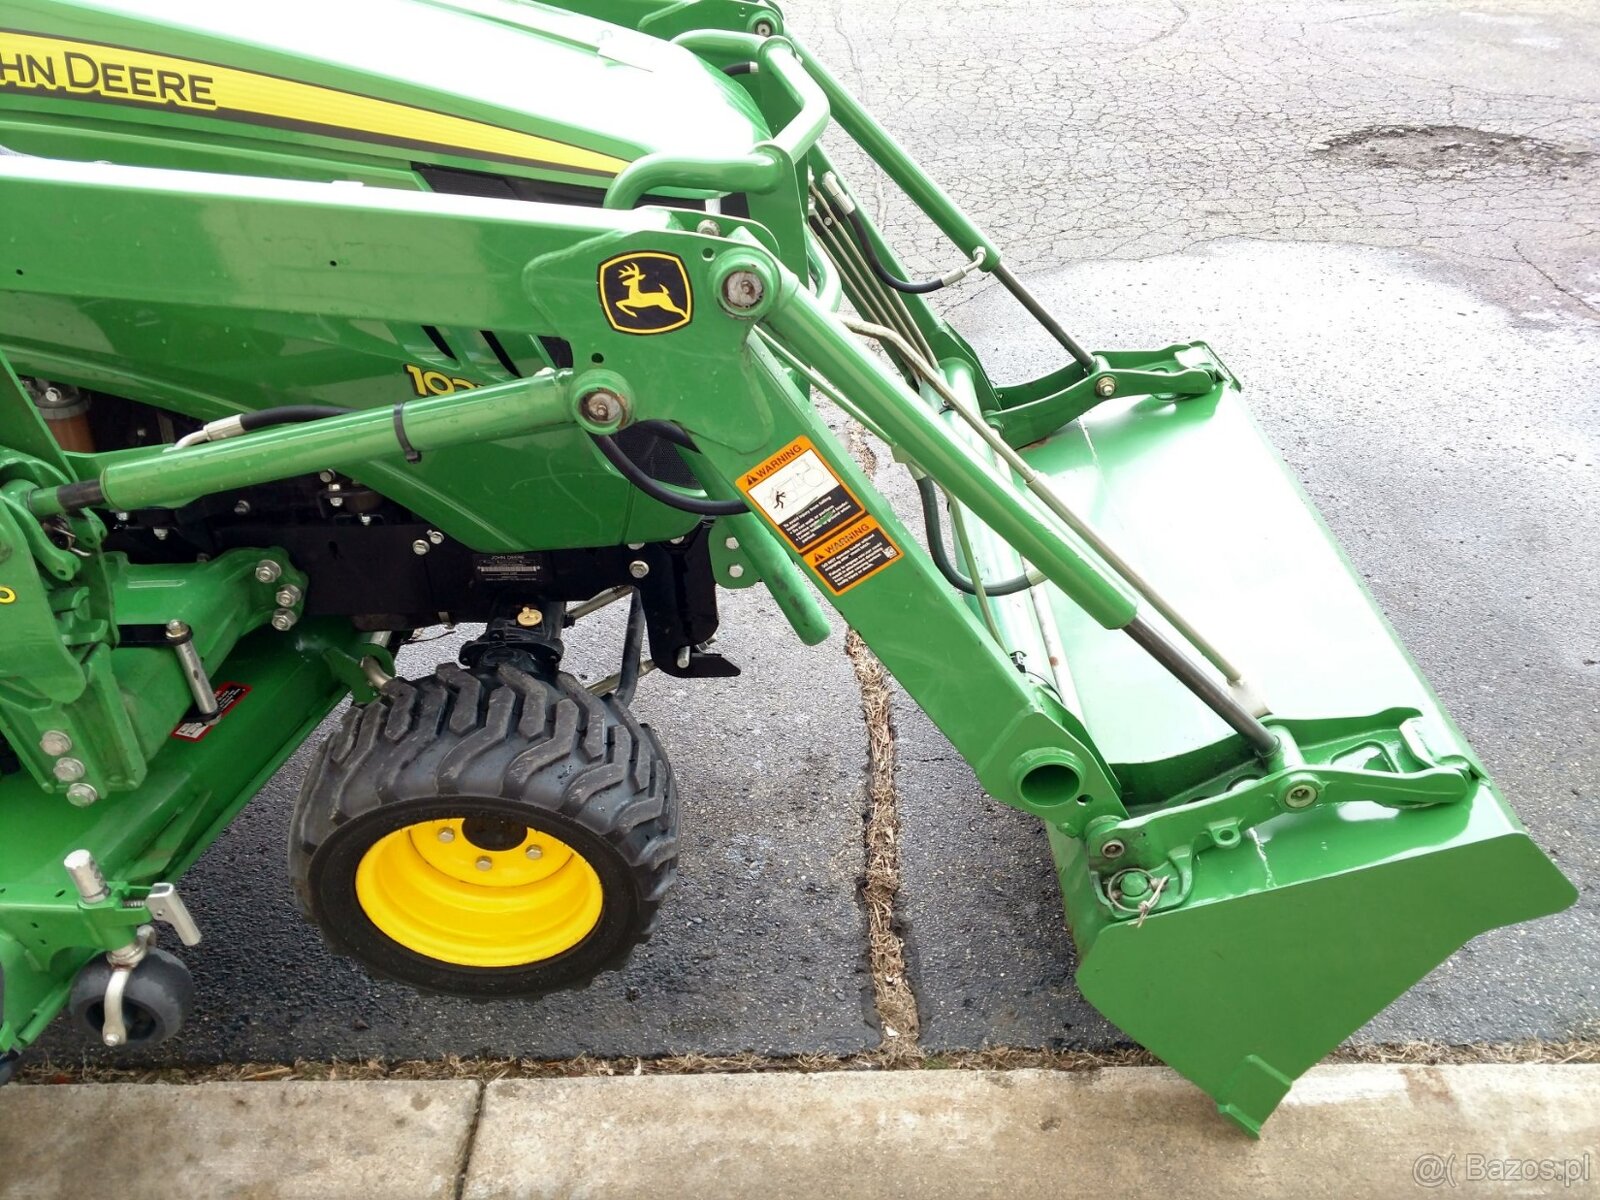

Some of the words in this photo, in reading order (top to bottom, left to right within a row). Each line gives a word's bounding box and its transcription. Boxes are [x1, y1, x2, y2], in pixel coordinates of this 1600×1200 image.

[64, 51, 216, 106] DEERE
[404, 364, 484, 397] 10
[757, 444, 802, 478] WARNING
[788, 516, 799, 524] avoid
[798, 509, 810, 518] injury
[809, 503, 819, 511] from
[824, 523, 870, 554] WARNING
